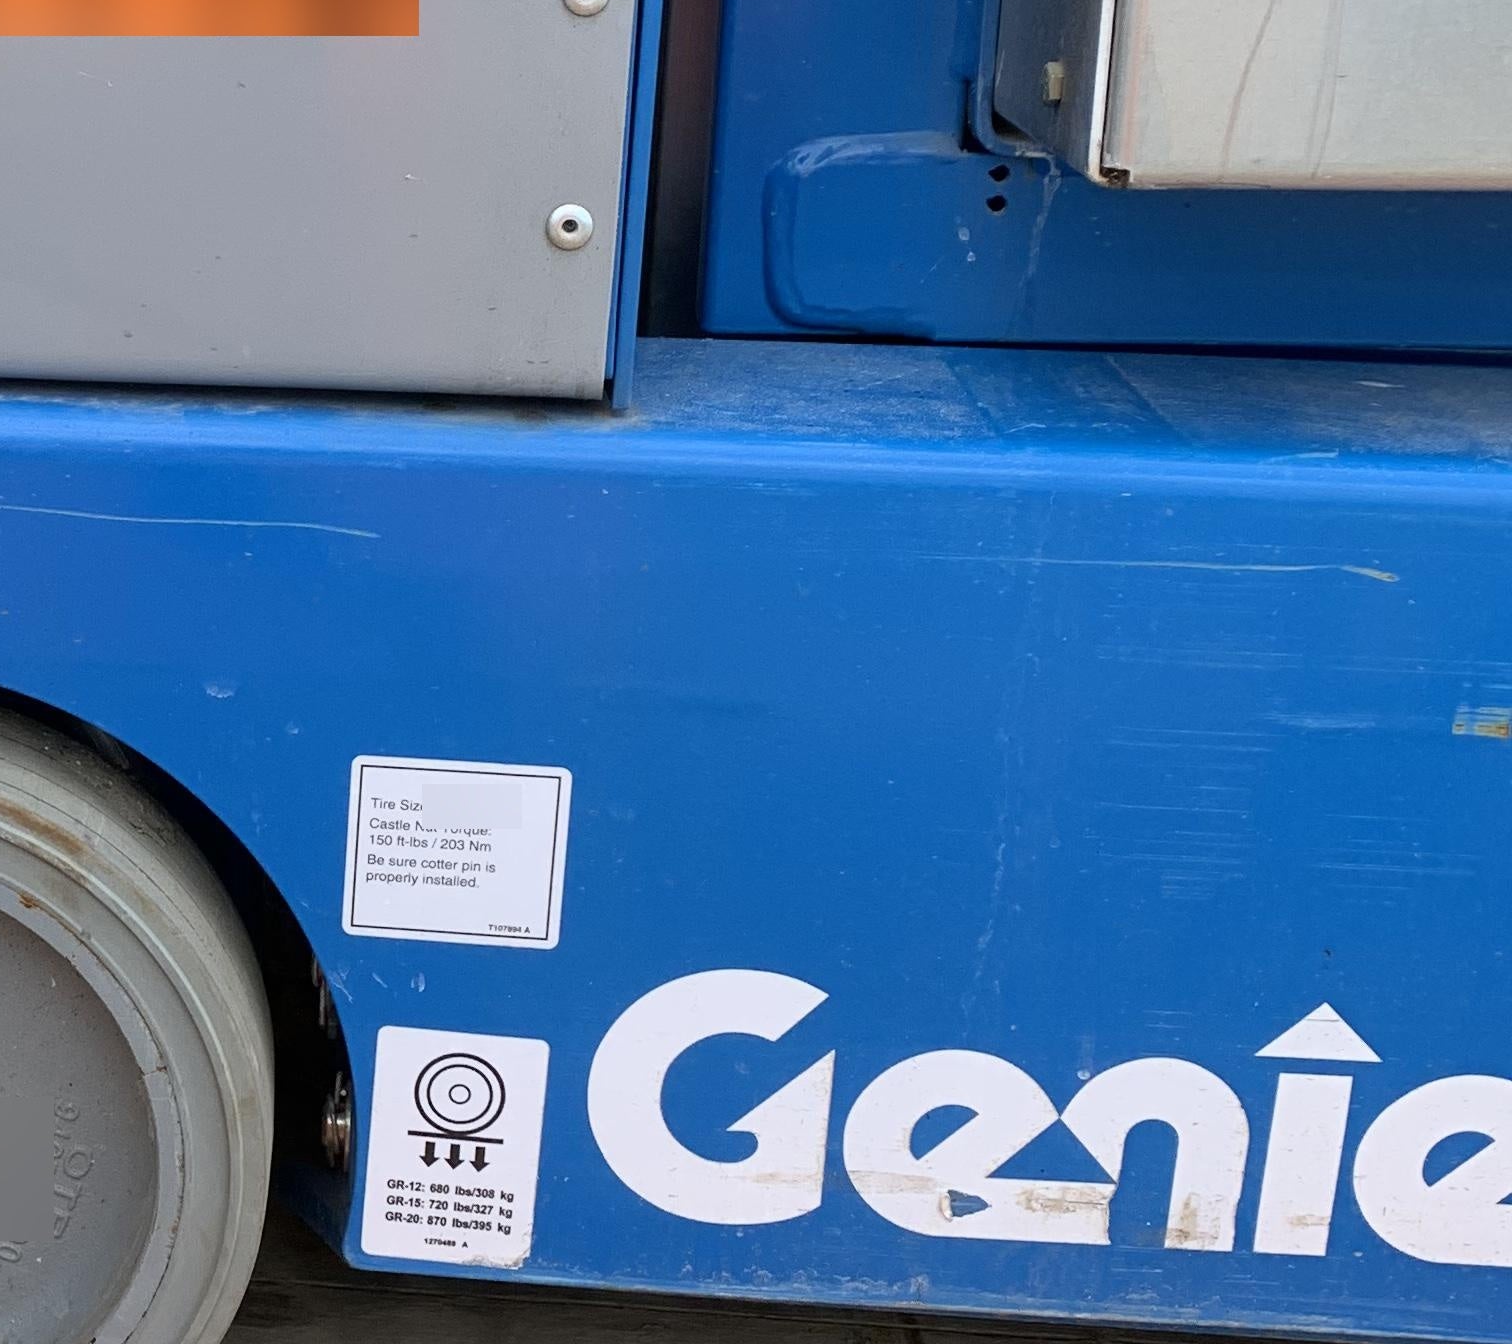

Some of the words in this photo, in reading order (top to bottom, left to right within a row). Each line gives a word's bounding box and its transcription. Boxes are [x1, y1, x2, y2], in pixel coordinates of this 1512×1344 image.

[370, 797, 396, 810] Tire
[399, 799, 423, 811] Siz
[369, 817, 410, 831] Castle
[370, 834, 393, 846] 150
[396, 835, 429, 848] ft-lbs
[431, 837, 438, 849] /
[439, 838, 465, 851] 203
[469, 840, 492, 852] Nm
[367, 853, 385, 866] Be
[388, 856, 417, 868] sure
[420, 858, 458, 871] cotter
[461, 860, 481, 874] pin
[485, 862, 496, 873] is
[365, 871, 419, 886] properly
[422, 873, 480, 888] installed.
[386, 1179, 425, 1192] GR-12:
[429, 1183, 450, 1194] 680
[454, 1186, 495, 1199] lbs/308
[500, 1190, 514, 1203] kg
[386, 1195, 425, 1208] GR-15:
[428, 1199, 448, 1210] 720
[453, 1202, 493, 1215] lbs/327
[499, 1207, 513, 1219] kg
[385, 1211, 423, 1224] GR-20:
[427, 1216, 447, 1226] 870
[452, 1218, 492, 1231] lbs/395
[497, 1223, 511, 1235] kg
